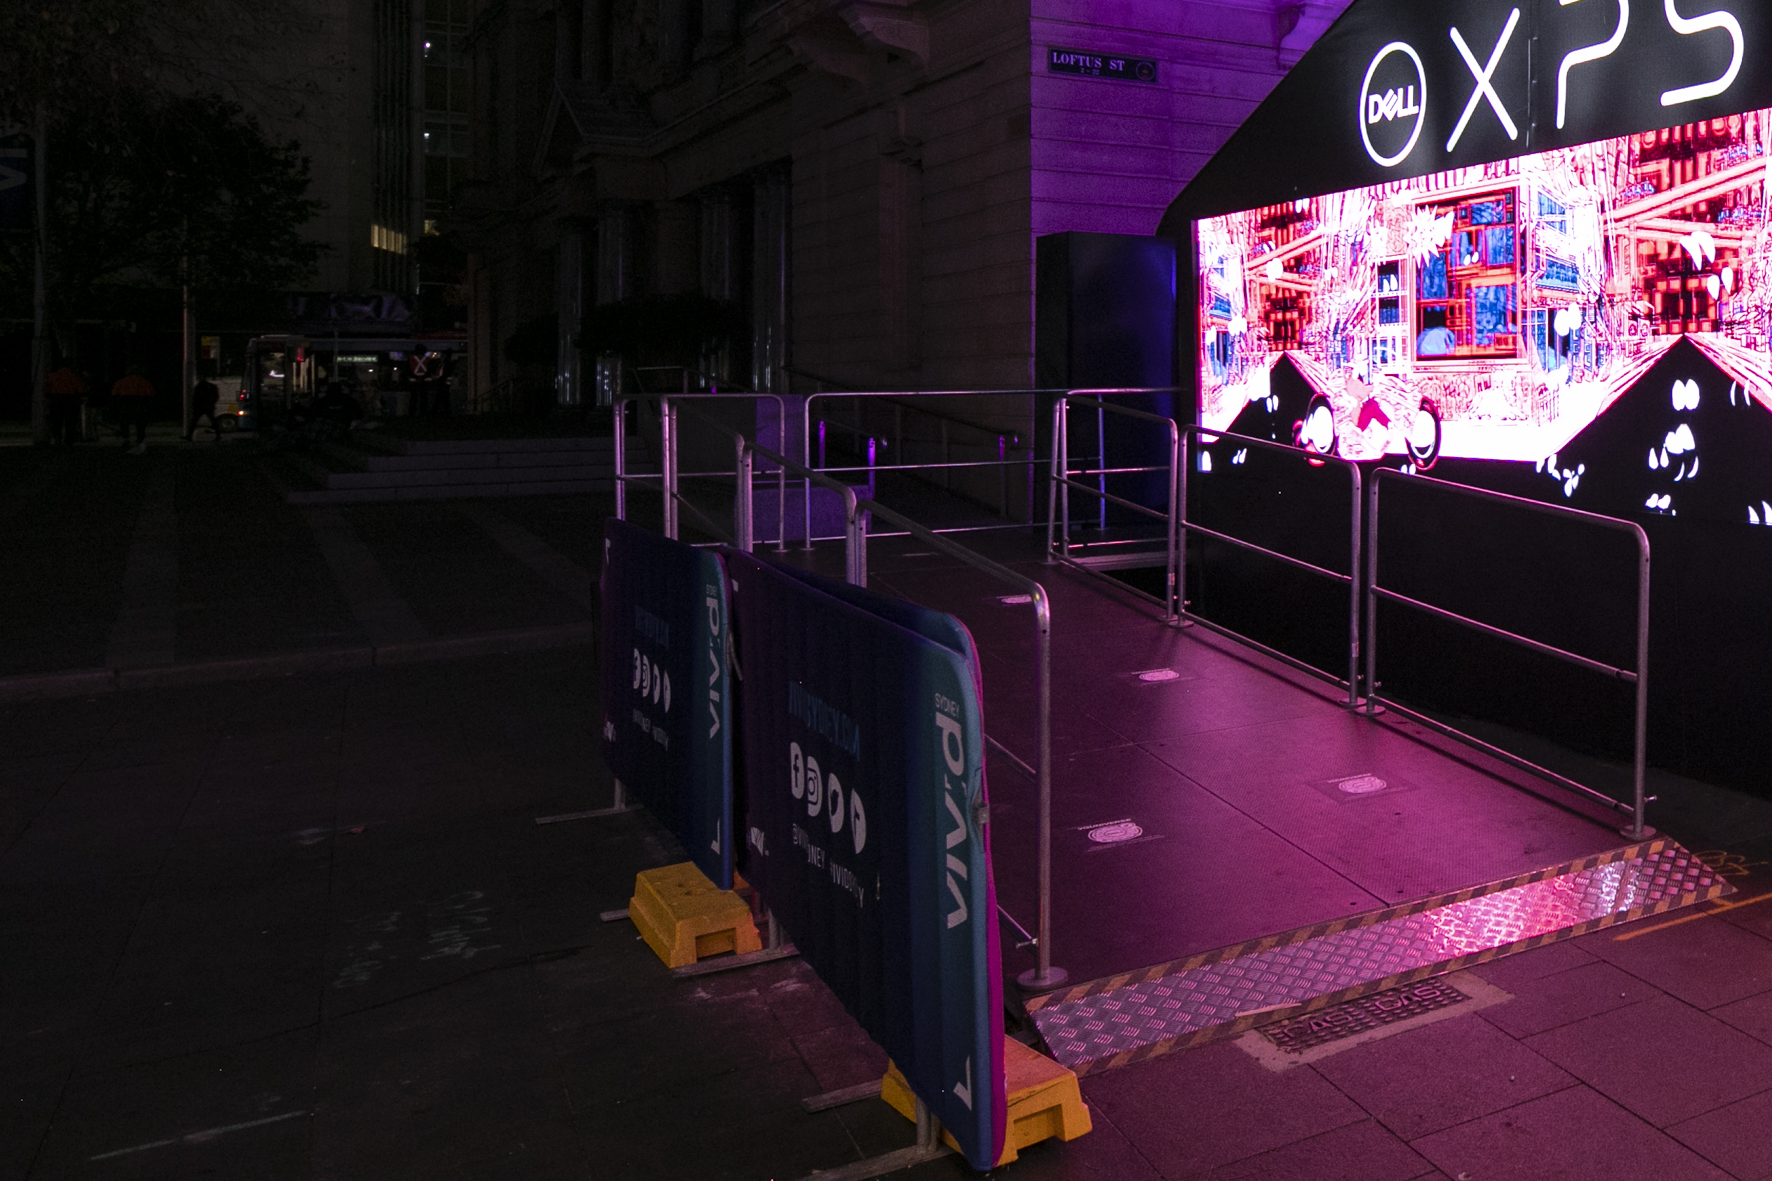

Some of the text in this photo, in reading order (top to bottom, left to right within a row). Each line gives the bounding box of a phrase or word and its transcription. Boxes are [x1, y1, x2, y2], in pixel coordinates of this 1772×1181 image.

[1052, 52, 1125, 71] LOFTUS ST
[1368, 84, 1420, 125] DELL
[934, 692, 960, 718] SYDNEY
